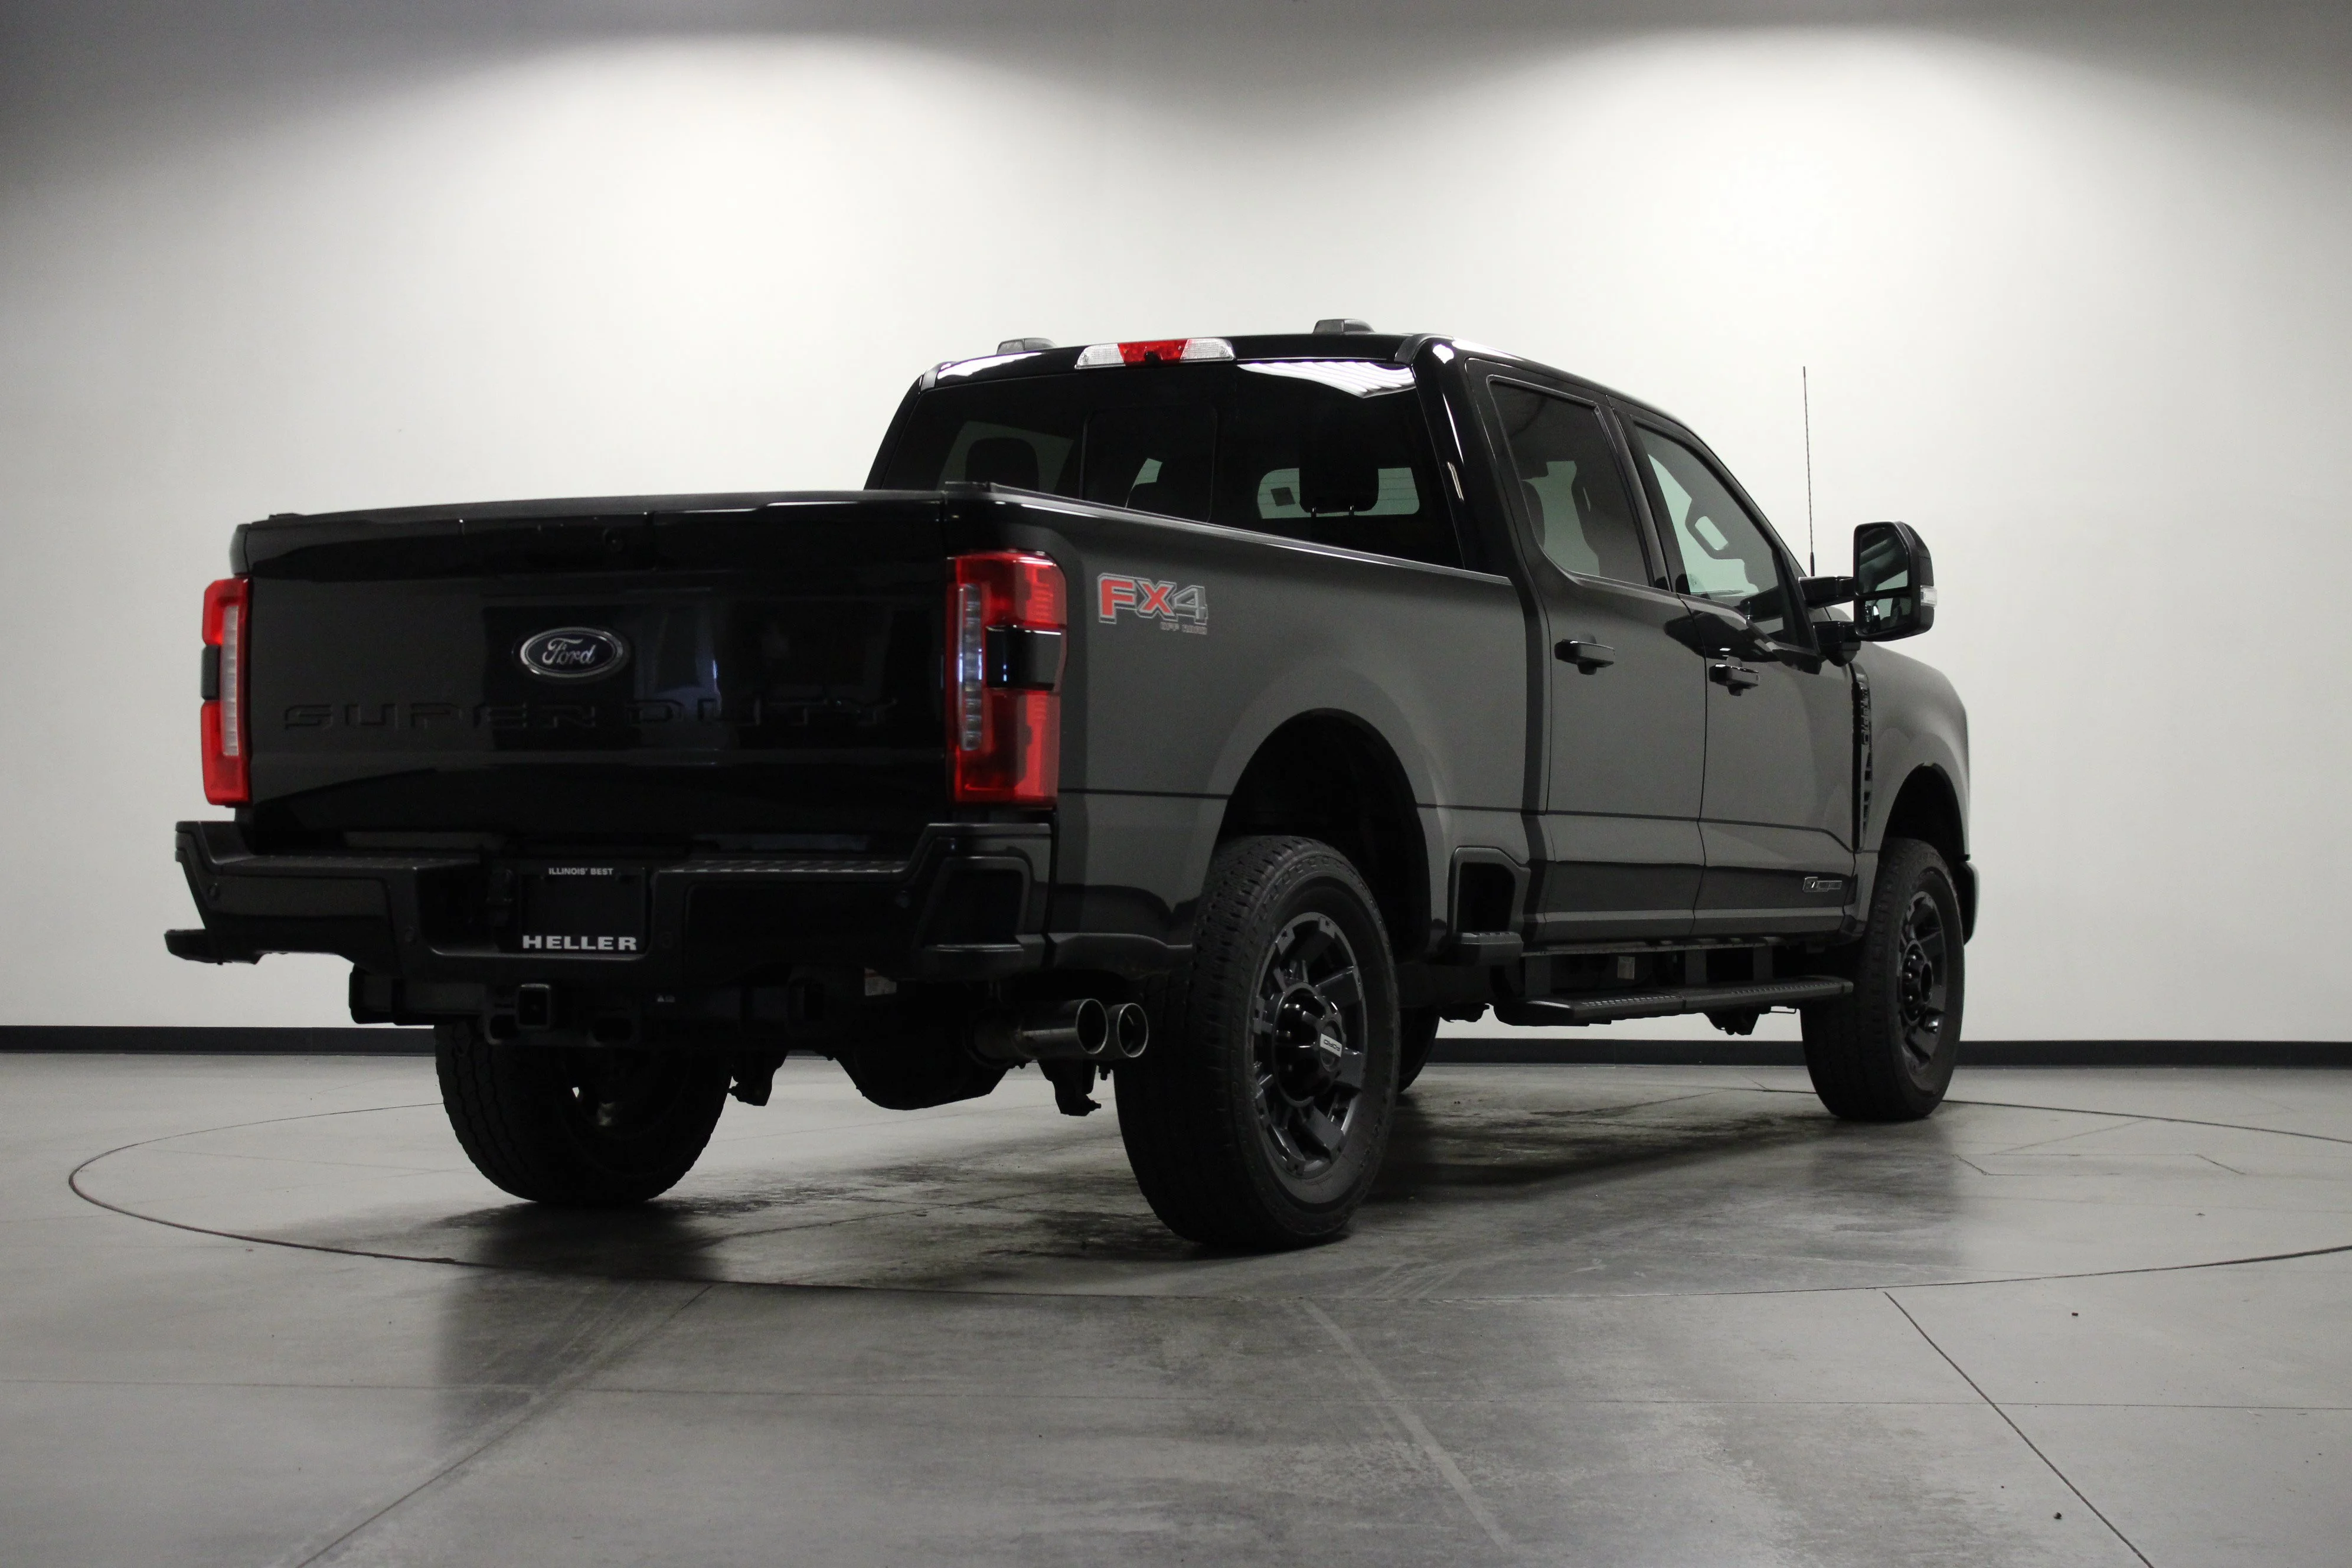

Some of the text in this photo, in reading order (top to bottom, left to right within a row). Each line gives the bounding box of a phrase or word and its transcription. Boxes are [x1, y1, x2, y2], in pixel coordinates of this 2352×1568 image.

[1098, 573, 1208, 625] FX4
[542, 638, 596, 665] Ford
[283, 698, 899, 730] SUPER DUTY
[522, 935, 637, 950] HELLER
